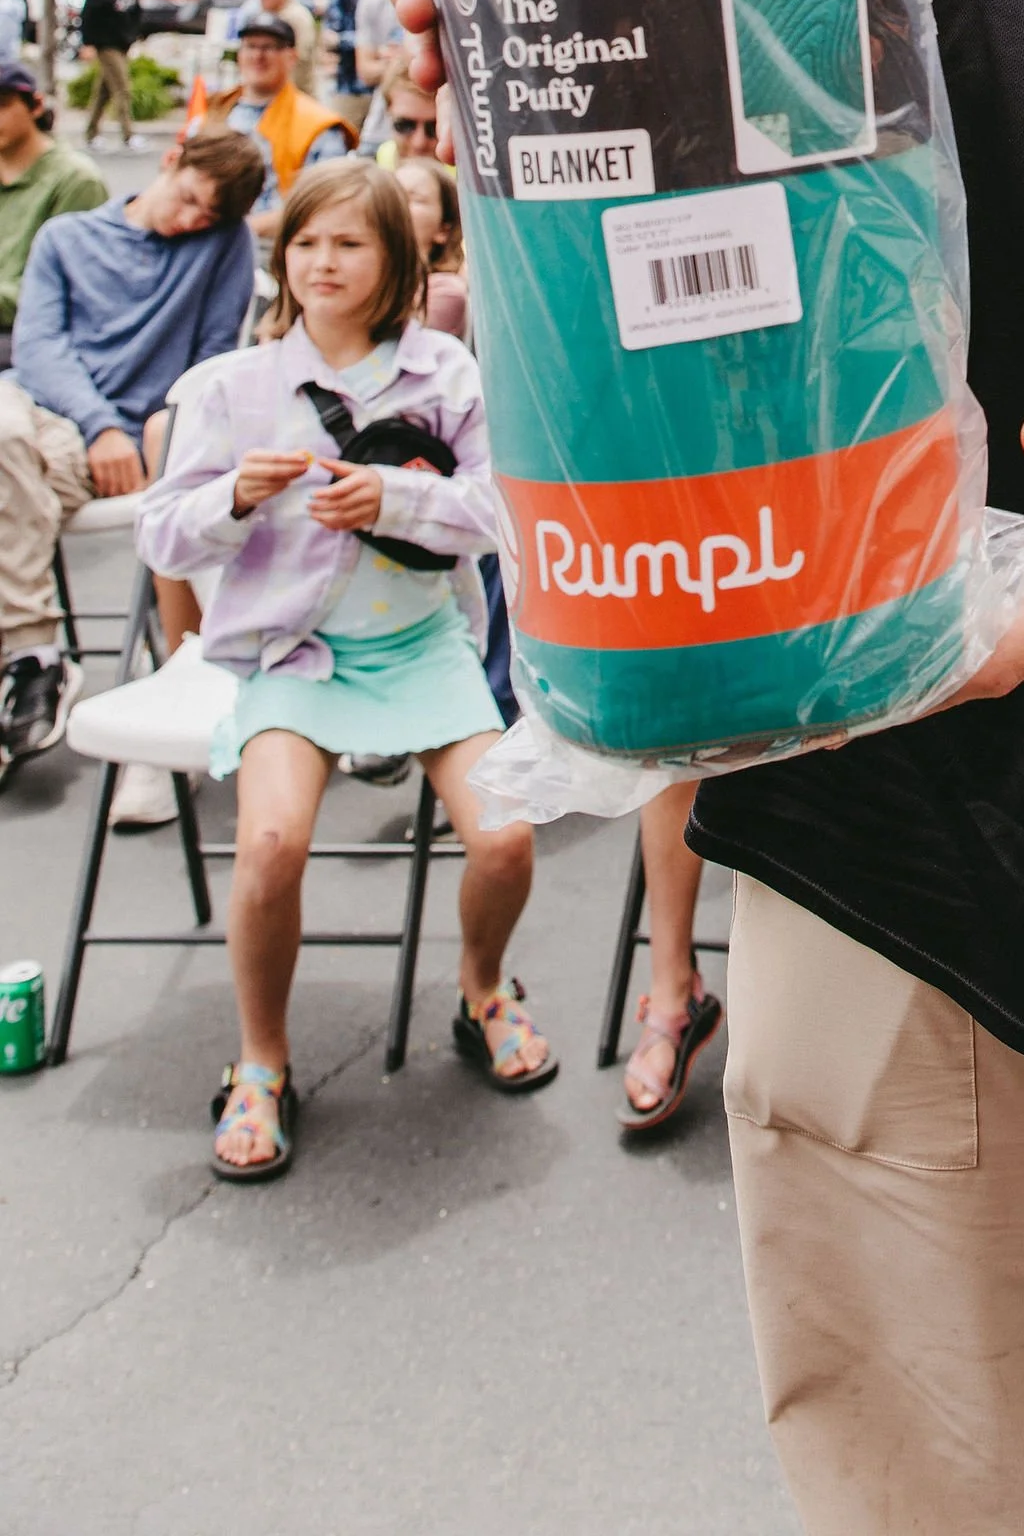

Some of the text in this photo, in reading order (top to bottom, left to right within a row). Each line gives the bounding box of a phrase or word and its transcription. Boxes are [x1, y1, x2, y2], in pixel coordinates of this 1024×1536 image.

[502, 26, 648, 74] Original
[505, 76, 595, 118] Puffy
[520, 145, 636, 185] BLANKET
[534, 505, 806, 614] Rumpl
